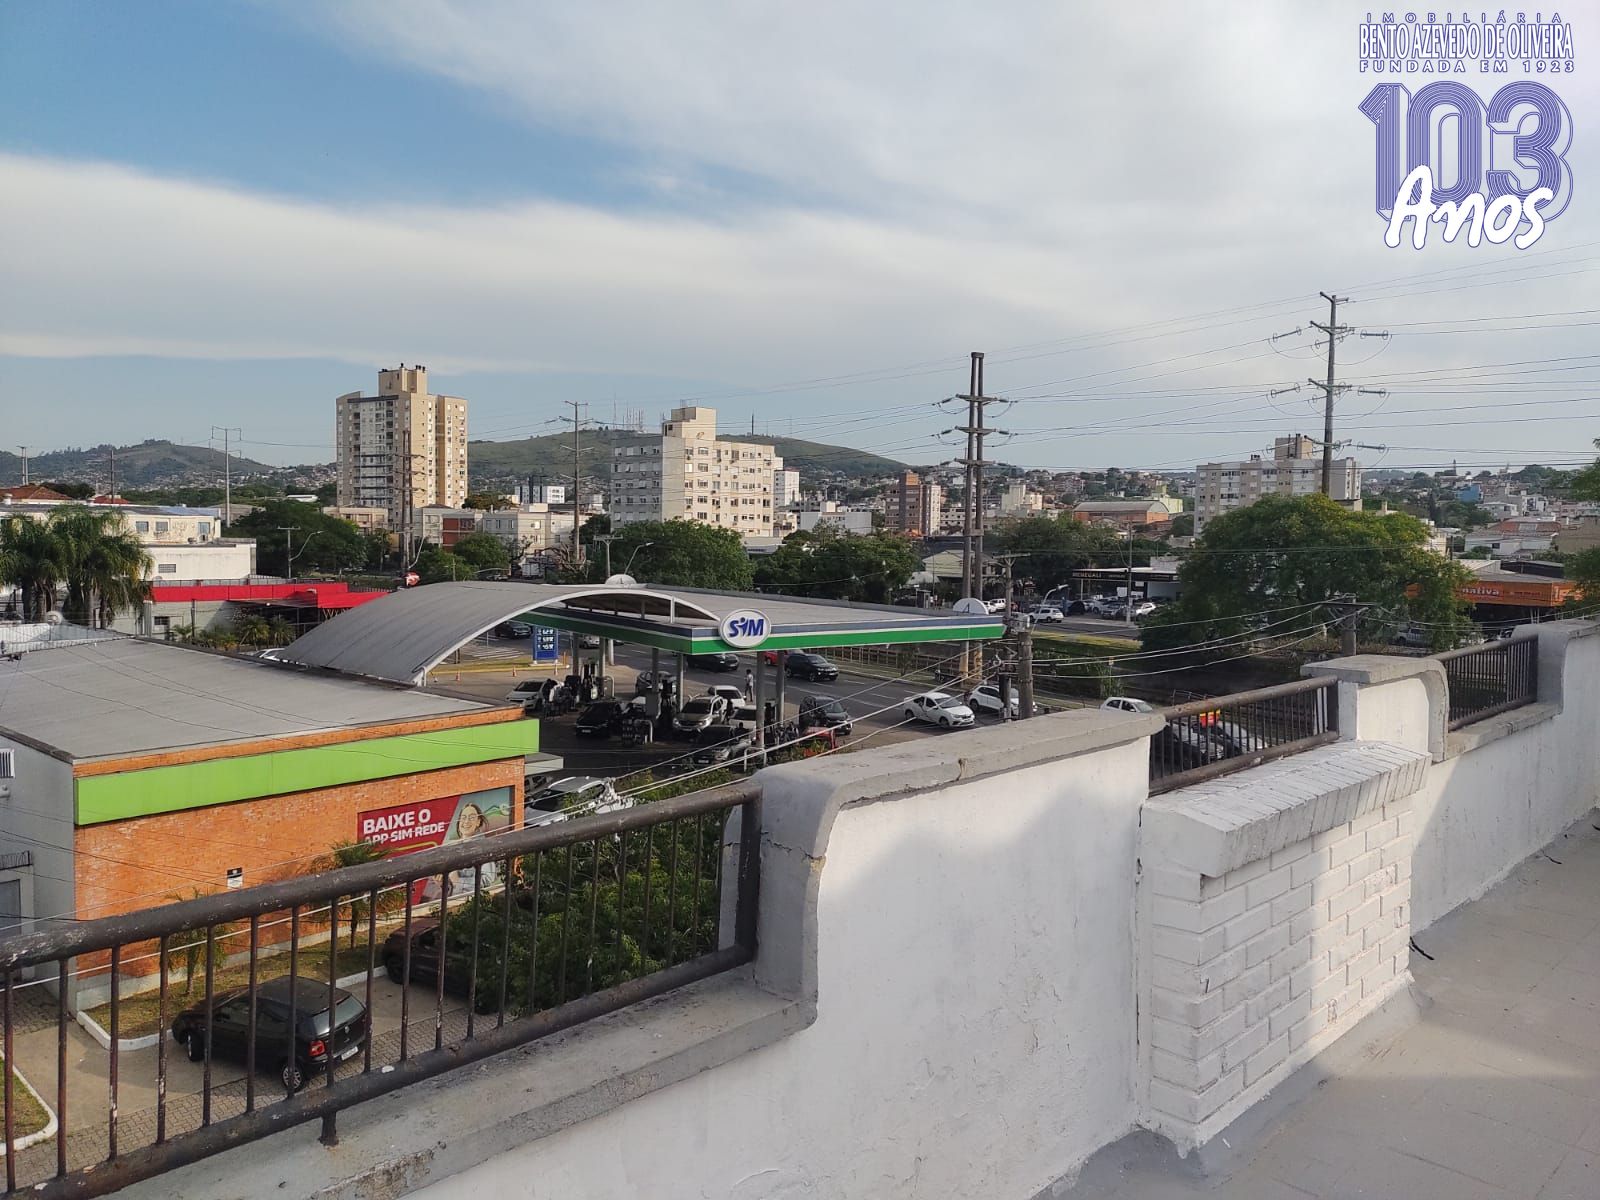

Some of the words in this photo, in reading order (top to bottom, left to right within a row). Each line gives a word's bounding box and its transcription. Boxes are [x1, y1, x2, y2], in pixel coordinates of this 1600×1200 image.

[729, 617, 764, 637] SIM
[363, 811, 415, 835] BAIXE
[418, 808, 431, 824] O
[364, 832, 389, 845] APP
[390, 828, 413, 842] SIM
[415, 821, 445, 838] REDE
